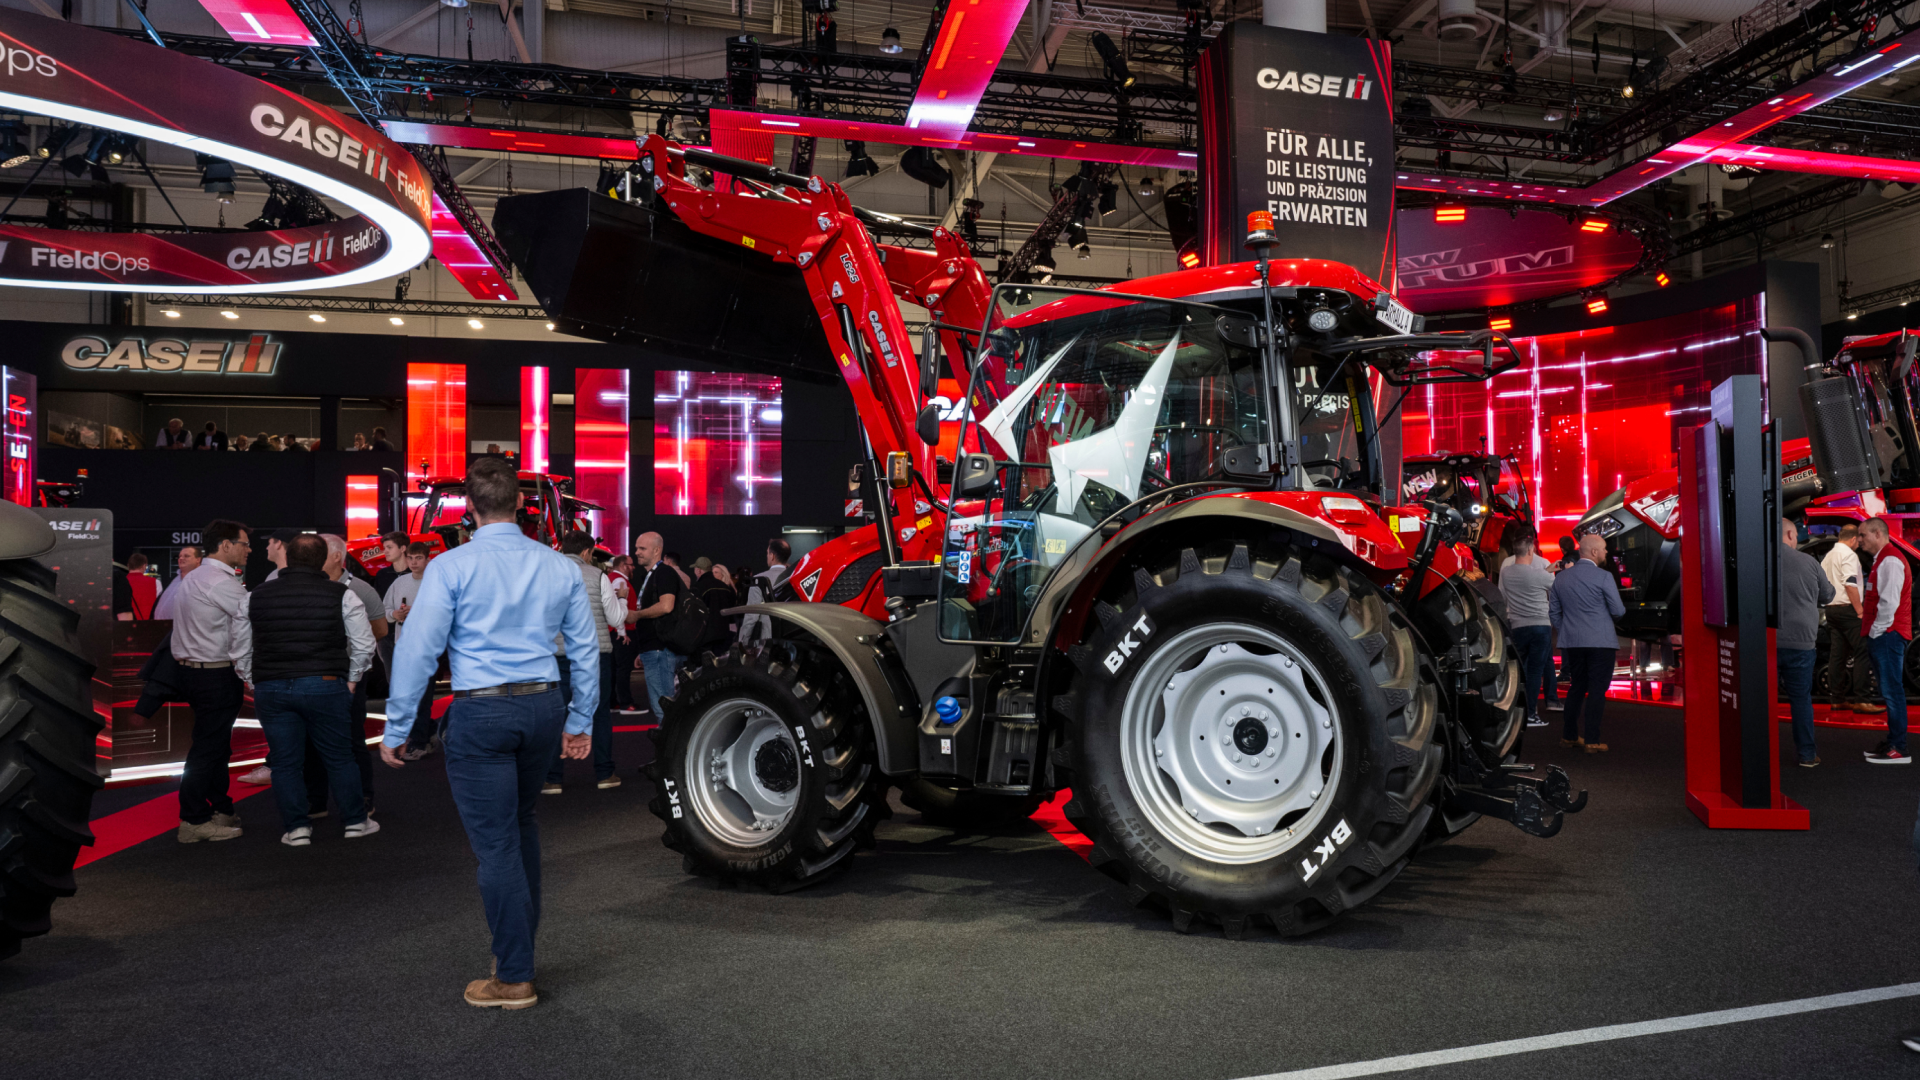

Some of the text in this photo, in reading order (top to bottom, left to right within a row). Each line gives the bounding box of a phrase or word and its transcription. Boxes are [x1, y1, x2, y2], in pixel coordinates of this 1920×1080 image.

[1256, 67, 1343, 97] CASE
[250, 103, 363, 169] CASE
[1266, 128, 1373, 166] FÜR ALLE,
[1266, 159, 1366, 184] DIE LEISTUNG
[1267, 180, 1367, 203] UND PRÄZISION
[1268, 200, 1367, 227] ERWARTEN
[31, 247, 150, 275] FieldOps
[226, 241, 311, 270] CASE
[840, 253, 860, 284] L625
[868, 310, 892, 355] CASE
[61, 337, 229, 372] CASE
[1403, 468, 1437, 498] NEW
[1783, 468, 1814, 484] TEIGER
[1650, 500, 1672, 517] 785
[362, 546, 381, 560] 260
[1103, 615, 1156, 675] BKT
[795, 725, 815, 768] BKT
[664, 778, 683, 819] BKT
[1303, 818, 1353, 882] BKT
